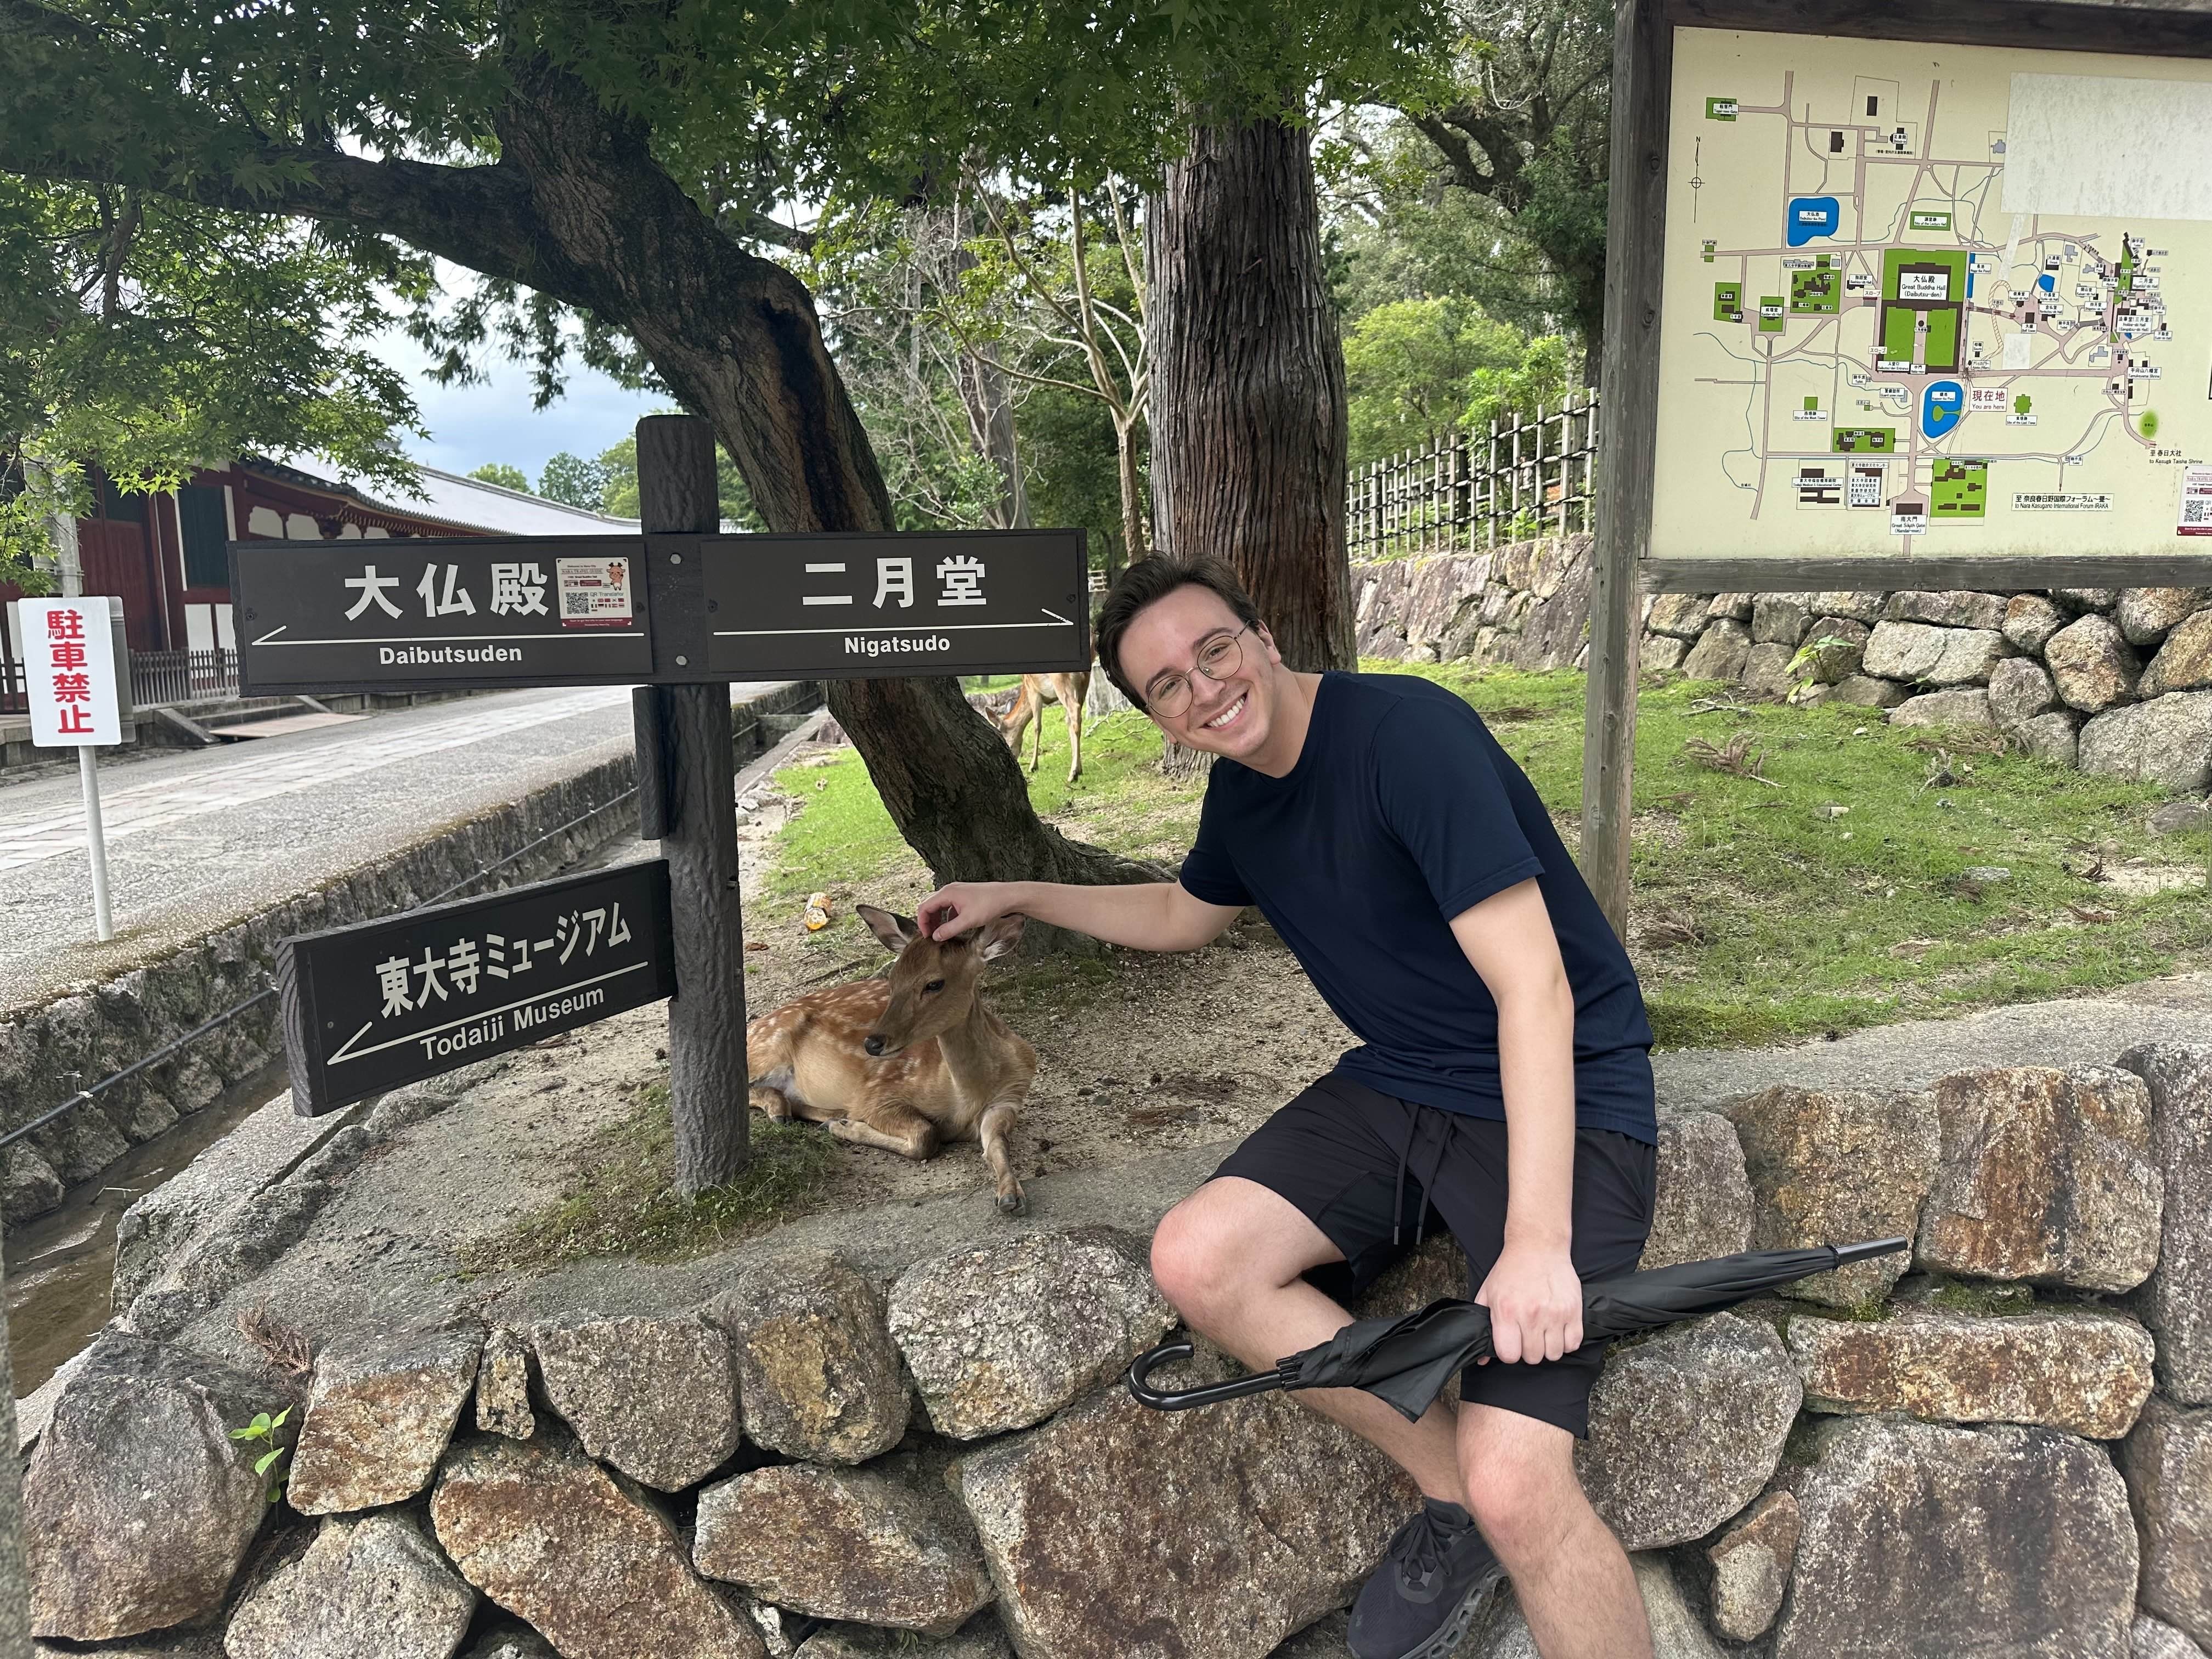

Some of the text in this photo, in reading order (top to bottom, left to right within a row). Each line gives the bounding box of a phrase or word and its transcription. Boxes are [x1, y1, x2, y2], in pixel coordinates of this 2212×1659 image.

[1972, 390, 2005, 401] 現在地
[345, 563, 549, 621] 大仏殿
[803, 555, 987, 608] 二月堂
[47, 609, 94, 733] 駐車禁止
[379, 645, 522, 665] Daibutsuden
[844, 635, 950, 657] Nigatsudo
[375, 902, 631, 1019] 東大寺ミュージアム
[420, 988, 605, 1060] Todaiji Museum
